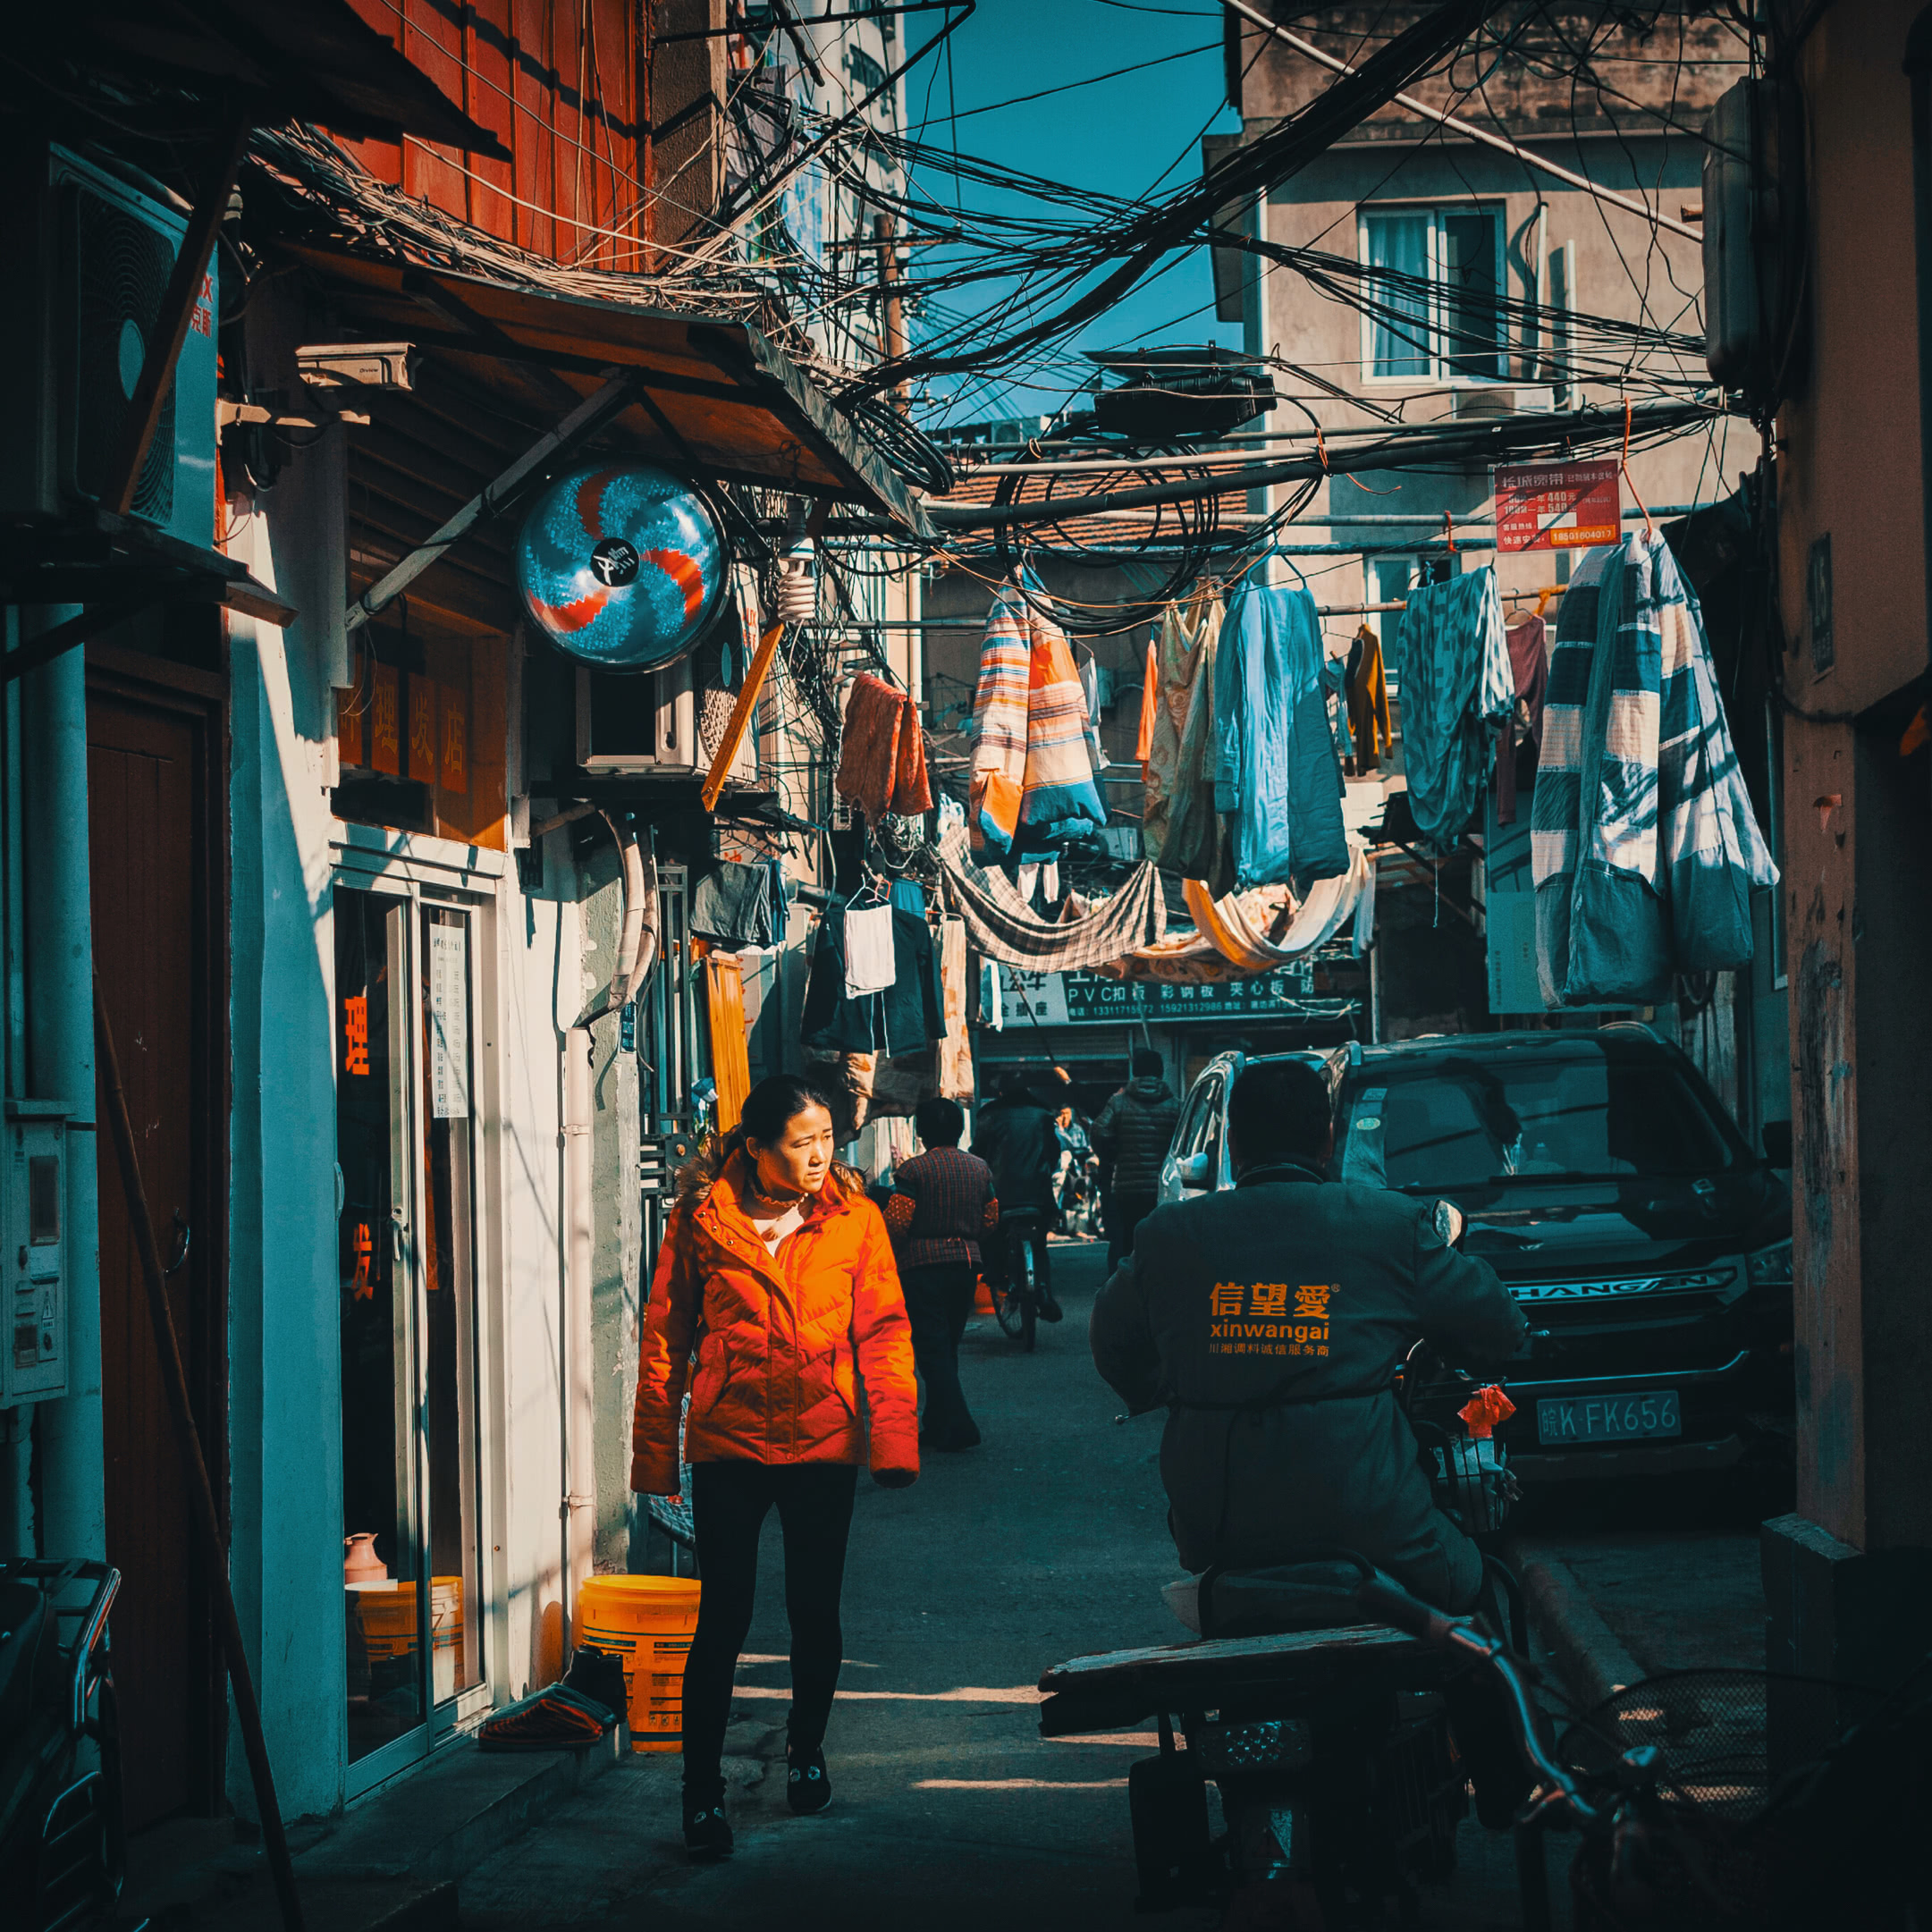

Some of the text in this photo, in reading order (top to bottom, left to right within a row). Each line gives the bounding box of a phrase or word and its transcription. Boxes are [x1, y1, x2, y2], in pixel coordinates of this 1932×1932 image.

[1502, 473, 1564, 488] 长城宽带
[1210, 1318, 1329, 1344] xinwangai
[1209, 1343, 1329, 1357] 川湘调料诚信服务商
